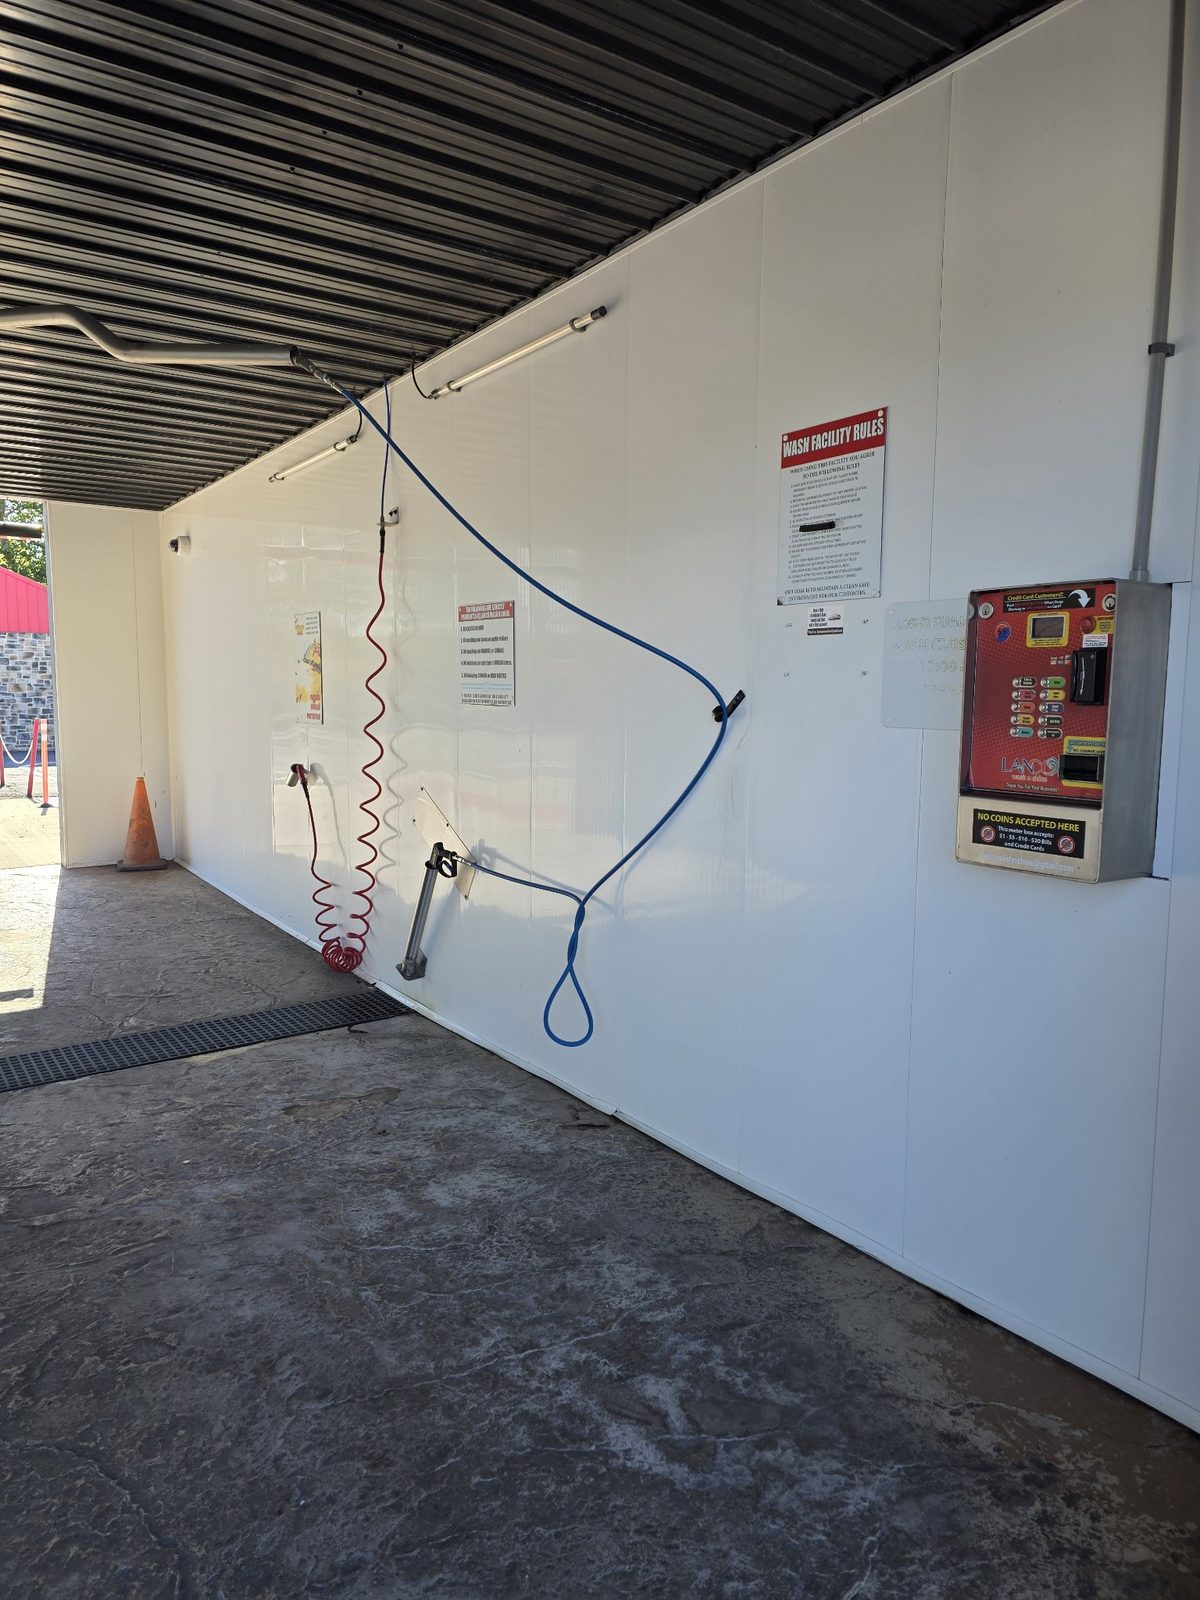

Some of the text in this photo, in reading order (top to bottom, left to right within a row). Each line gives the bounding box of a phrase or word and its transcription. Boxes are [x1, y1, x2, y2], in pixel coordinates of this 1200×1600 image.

[783, 418, 884, 458] WASH FACILITY RULES
[977, 812, 1080, 833] NO COINS ACCEPTED HERE
